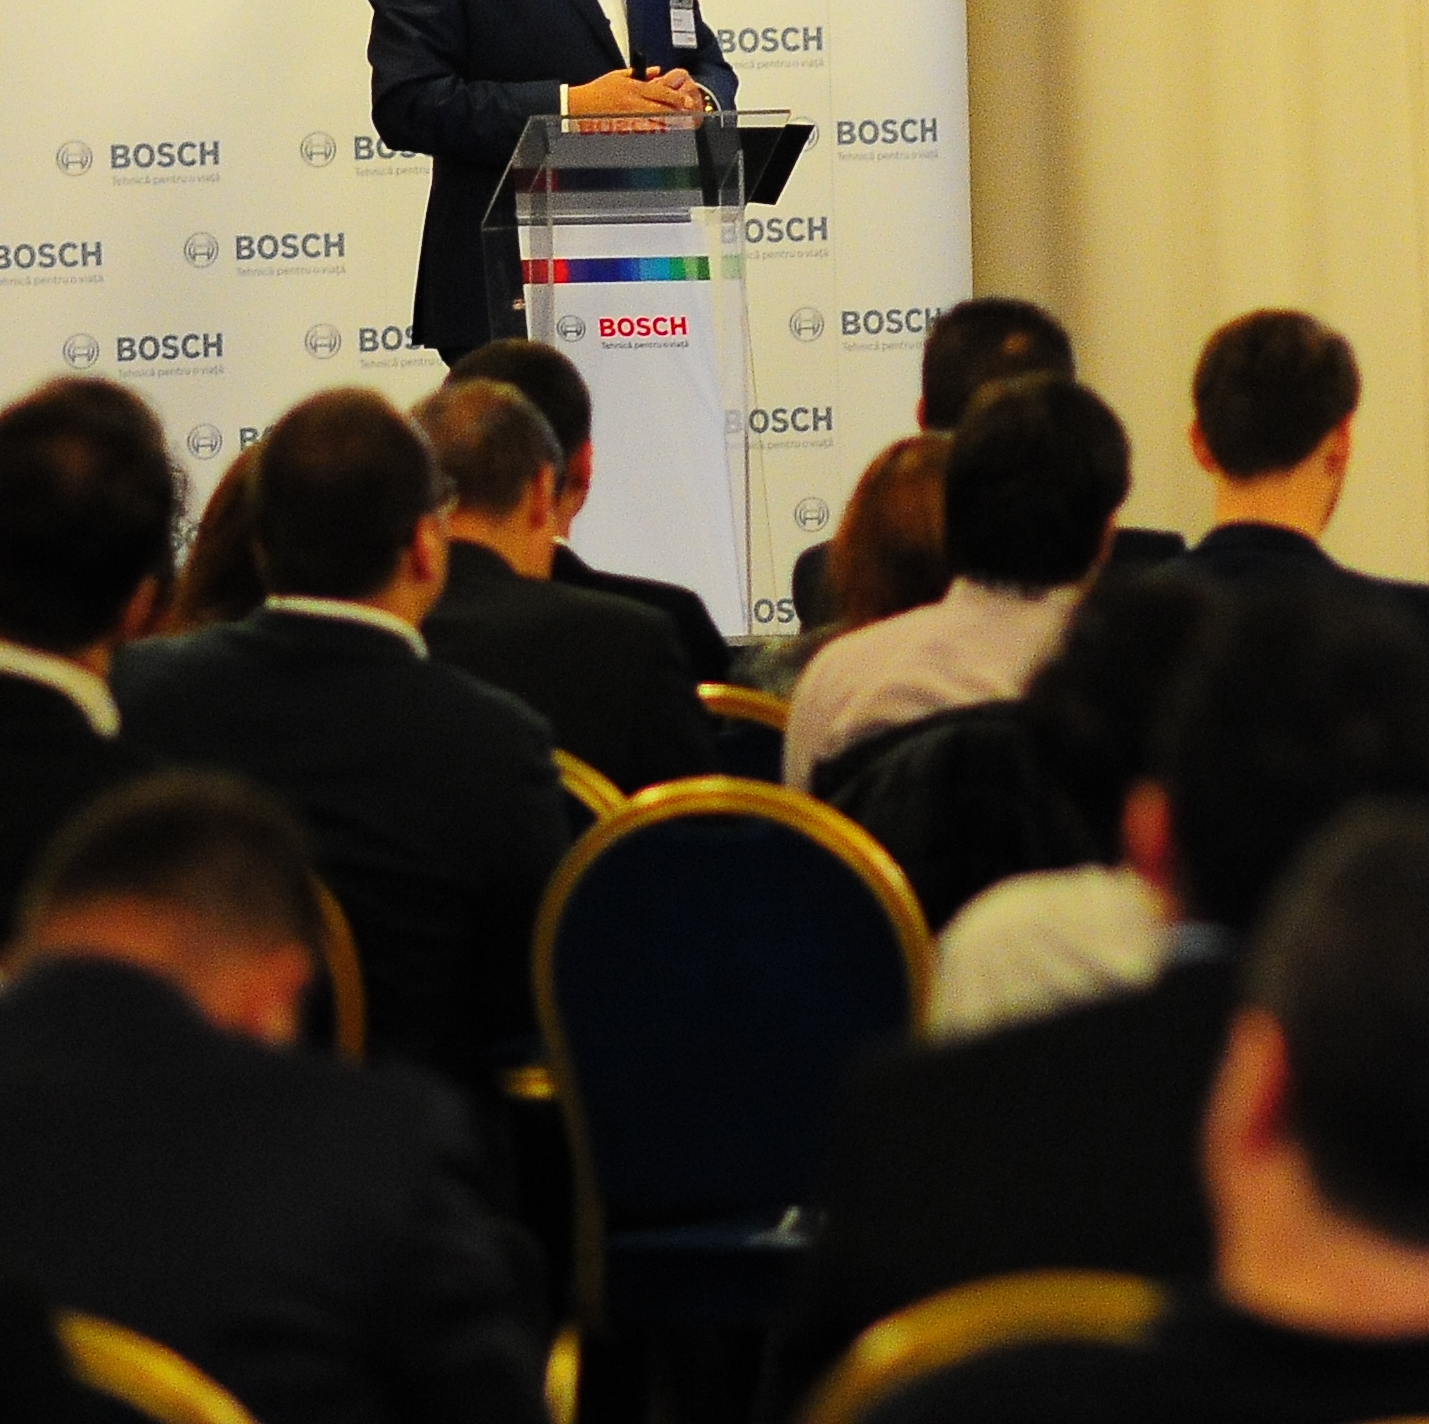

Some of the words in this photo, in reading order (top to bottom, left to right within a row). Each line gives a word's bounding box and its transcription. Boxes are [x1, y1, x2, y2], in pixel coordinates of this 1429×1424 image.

[717, 25, 824, 54] BOSCH
[836, 117, 938, 146] BOSCH
[110, 140, 220, 170] BOSCH
[235, 232, 345, 261] BOSCH
[599, 316, 688, 337] BOSCH
[116, 332, 223, 362] BOSCH
